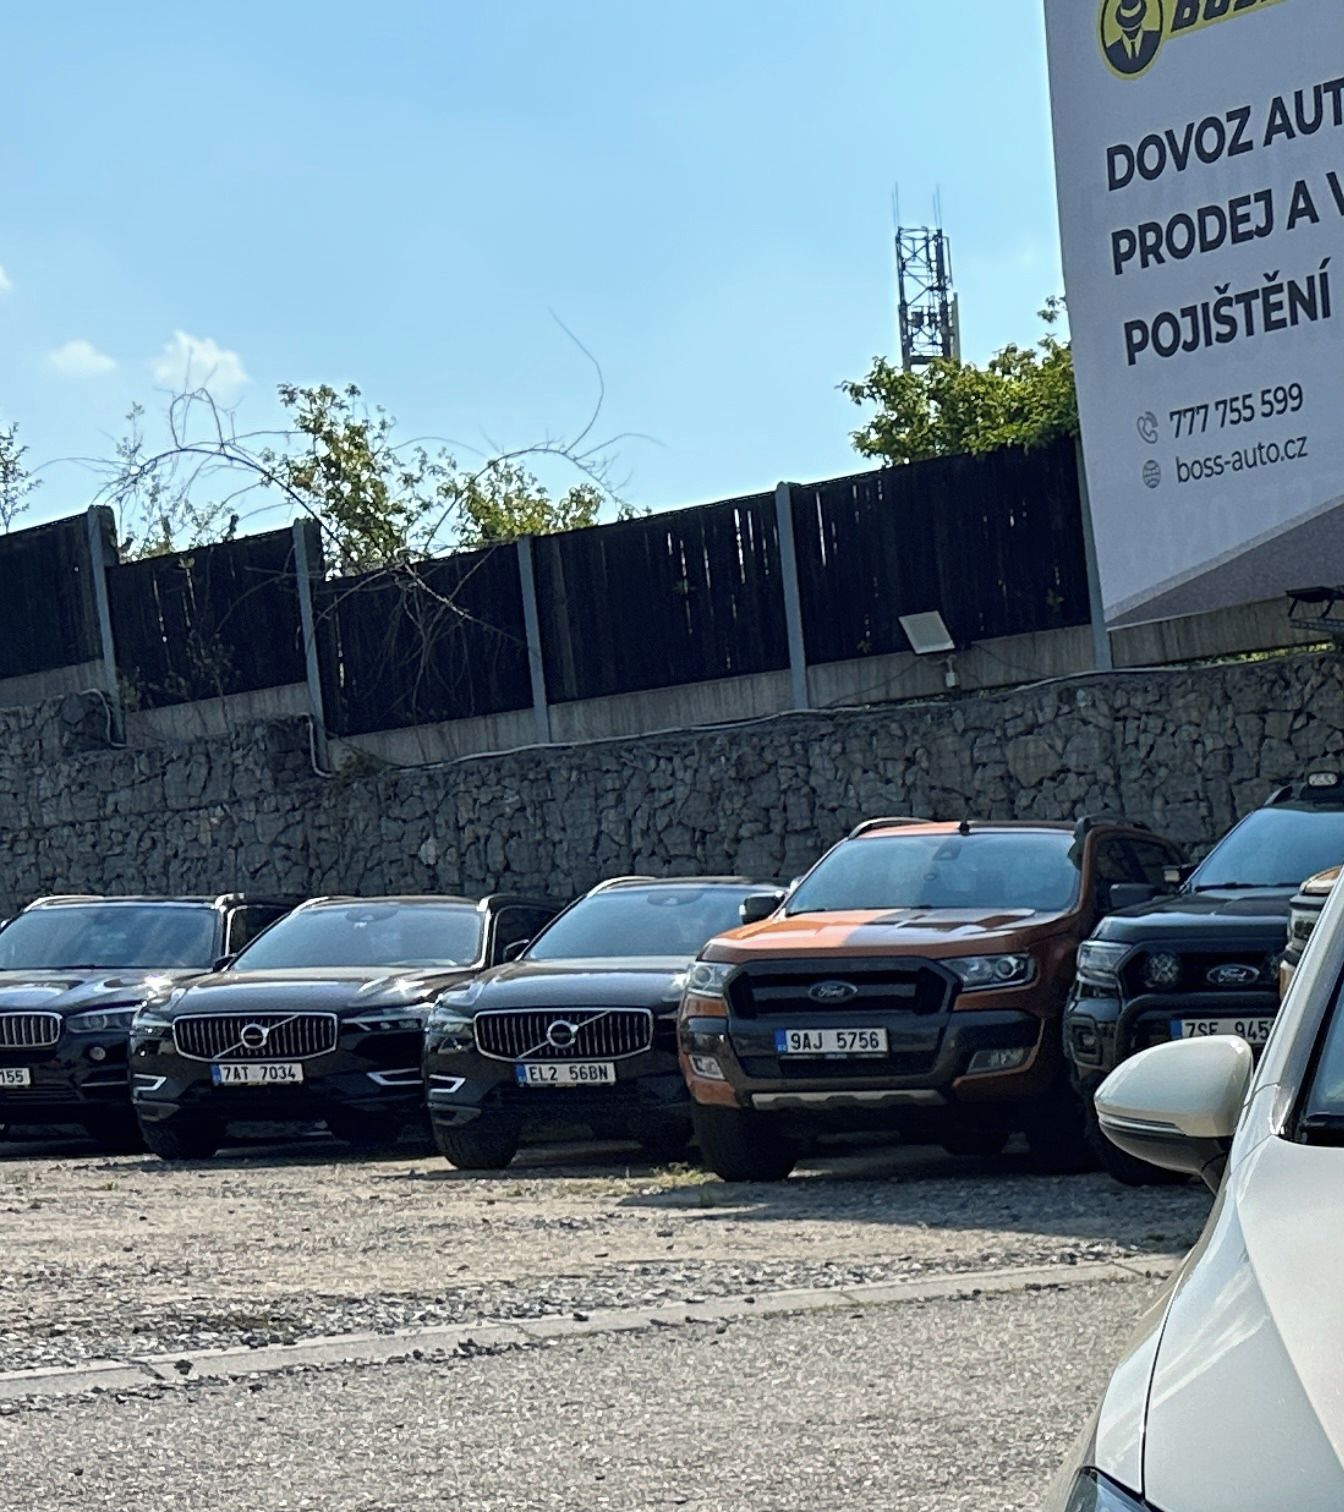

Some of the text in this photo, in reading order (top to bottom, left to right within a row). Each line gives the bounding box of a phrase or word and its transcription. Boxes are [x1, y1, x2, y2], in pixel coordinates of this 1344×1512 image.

[1106, 105, 1254, 192] DOVOZ
[1111, 188, 1274, 276] PRODEJ
[1286, 179, 1320, 230] A
[1124, 256, 1331, 366] POJIŠTĚNÍ
[1169, 382, 1303, 439] 777 755 599
[1176, 436, 1308, 484] boss-auto.cz
[790, 1032, 823, 1051] 9AJ
[836, 1031, 880, 1050] 5756
[1234, 1020, 1274, 1041] 945
[222, 1065, 297, 1081] 7AT 7034
[528, 1065, 559, 1082] EL2
